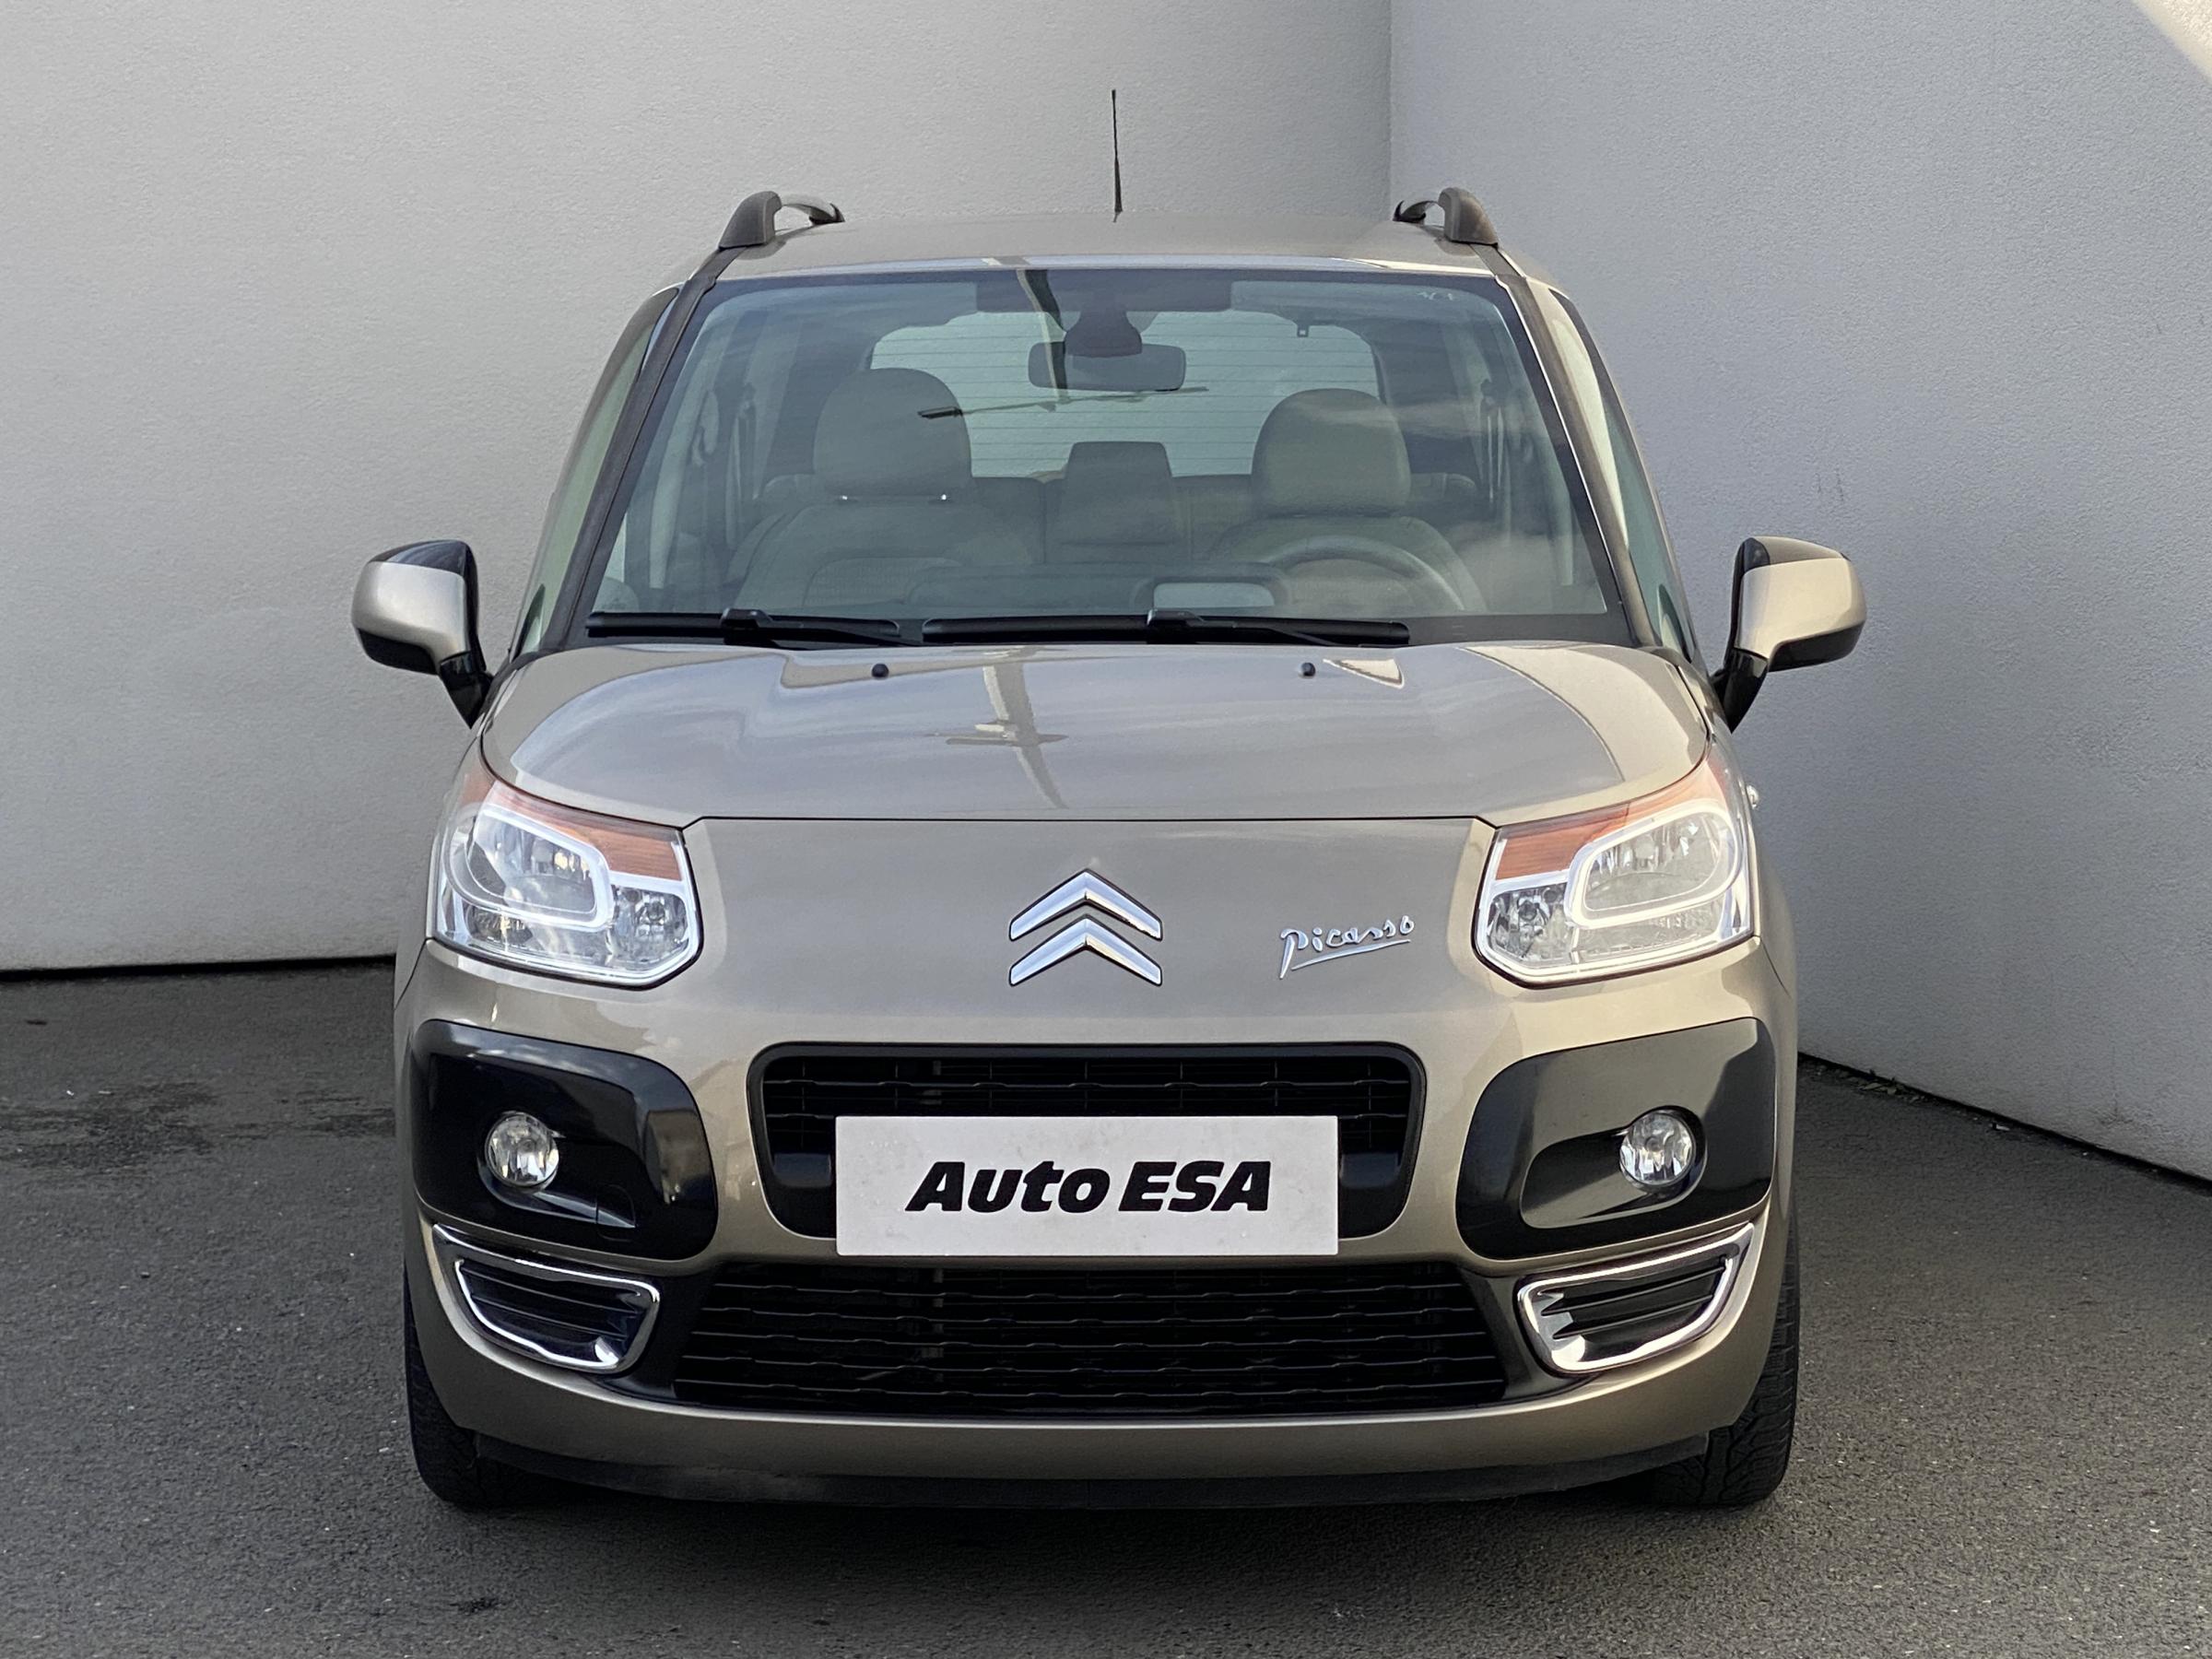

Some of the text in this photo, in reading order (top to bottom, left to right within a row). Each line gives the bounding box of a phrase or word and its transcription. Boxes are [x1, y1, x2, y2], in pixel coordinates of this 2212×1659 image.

[1279, 914, 1415, 979] Picasso
[905, 1160, 1271, 1213] Auto ESA
